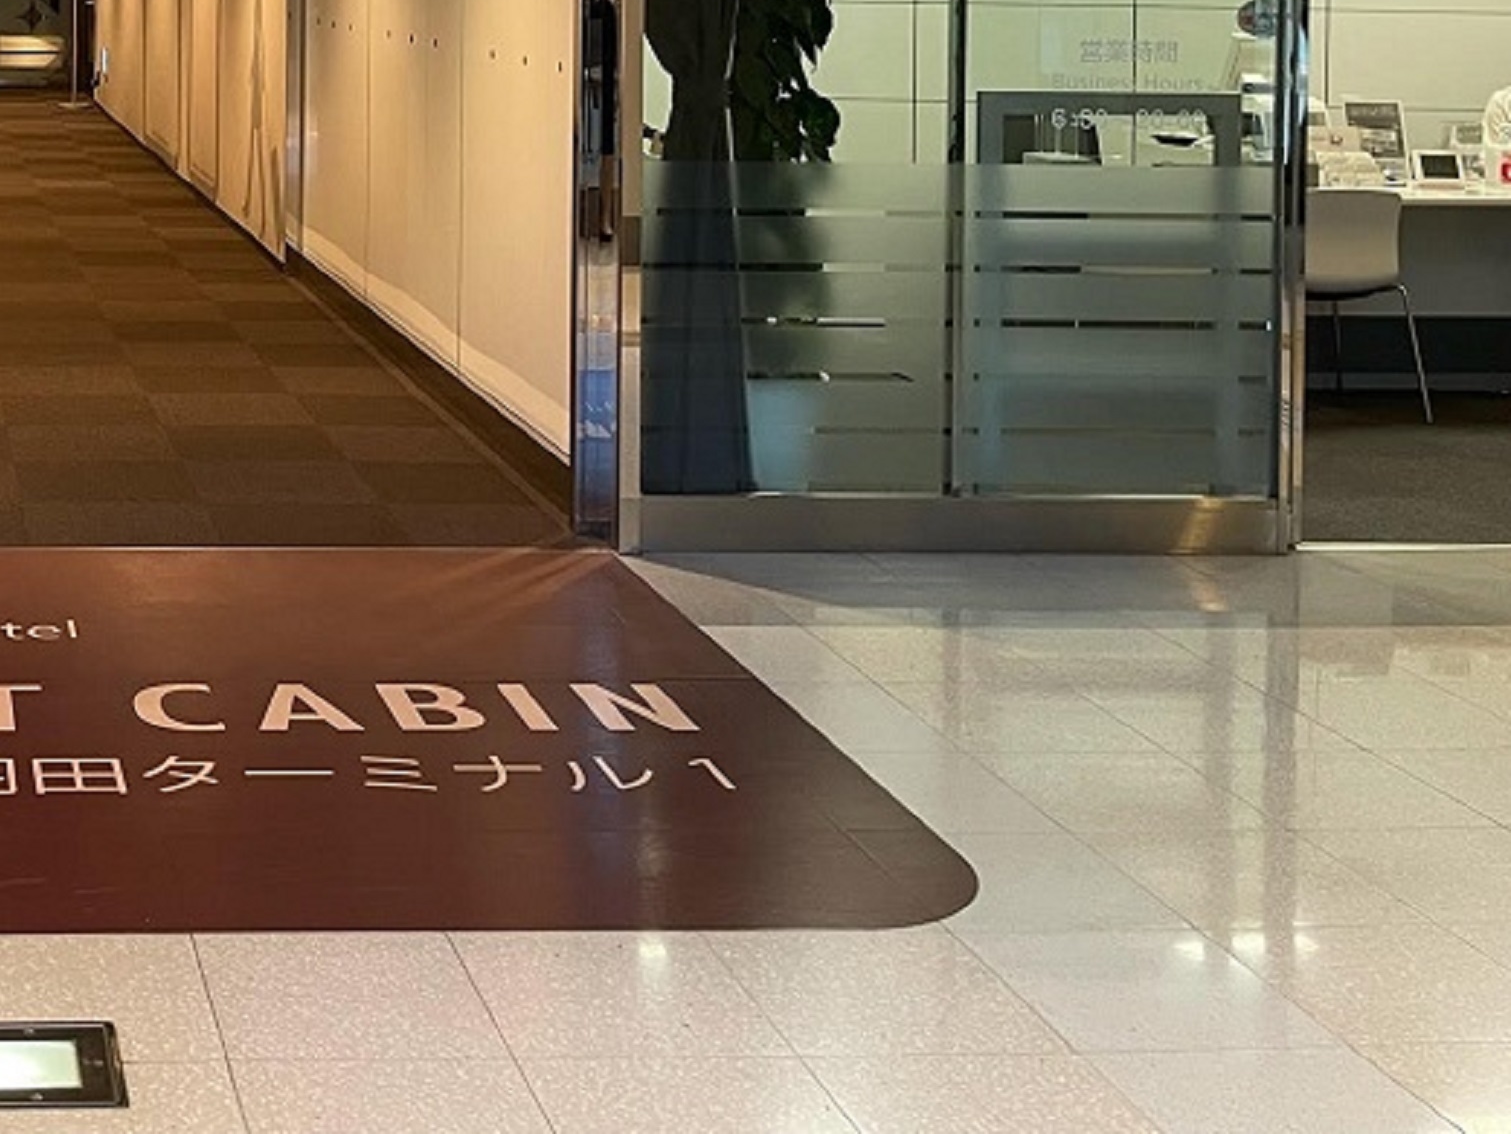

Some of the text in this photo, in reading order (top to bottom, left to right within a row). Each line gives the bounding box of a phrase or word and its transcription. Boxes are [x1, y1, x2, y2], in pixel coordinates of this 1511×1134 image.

[1080, 39, 1179, 64] 営業時間
[1051, 73, 1136, 89] Busines
[131, 682, 702, 733] CABIN
